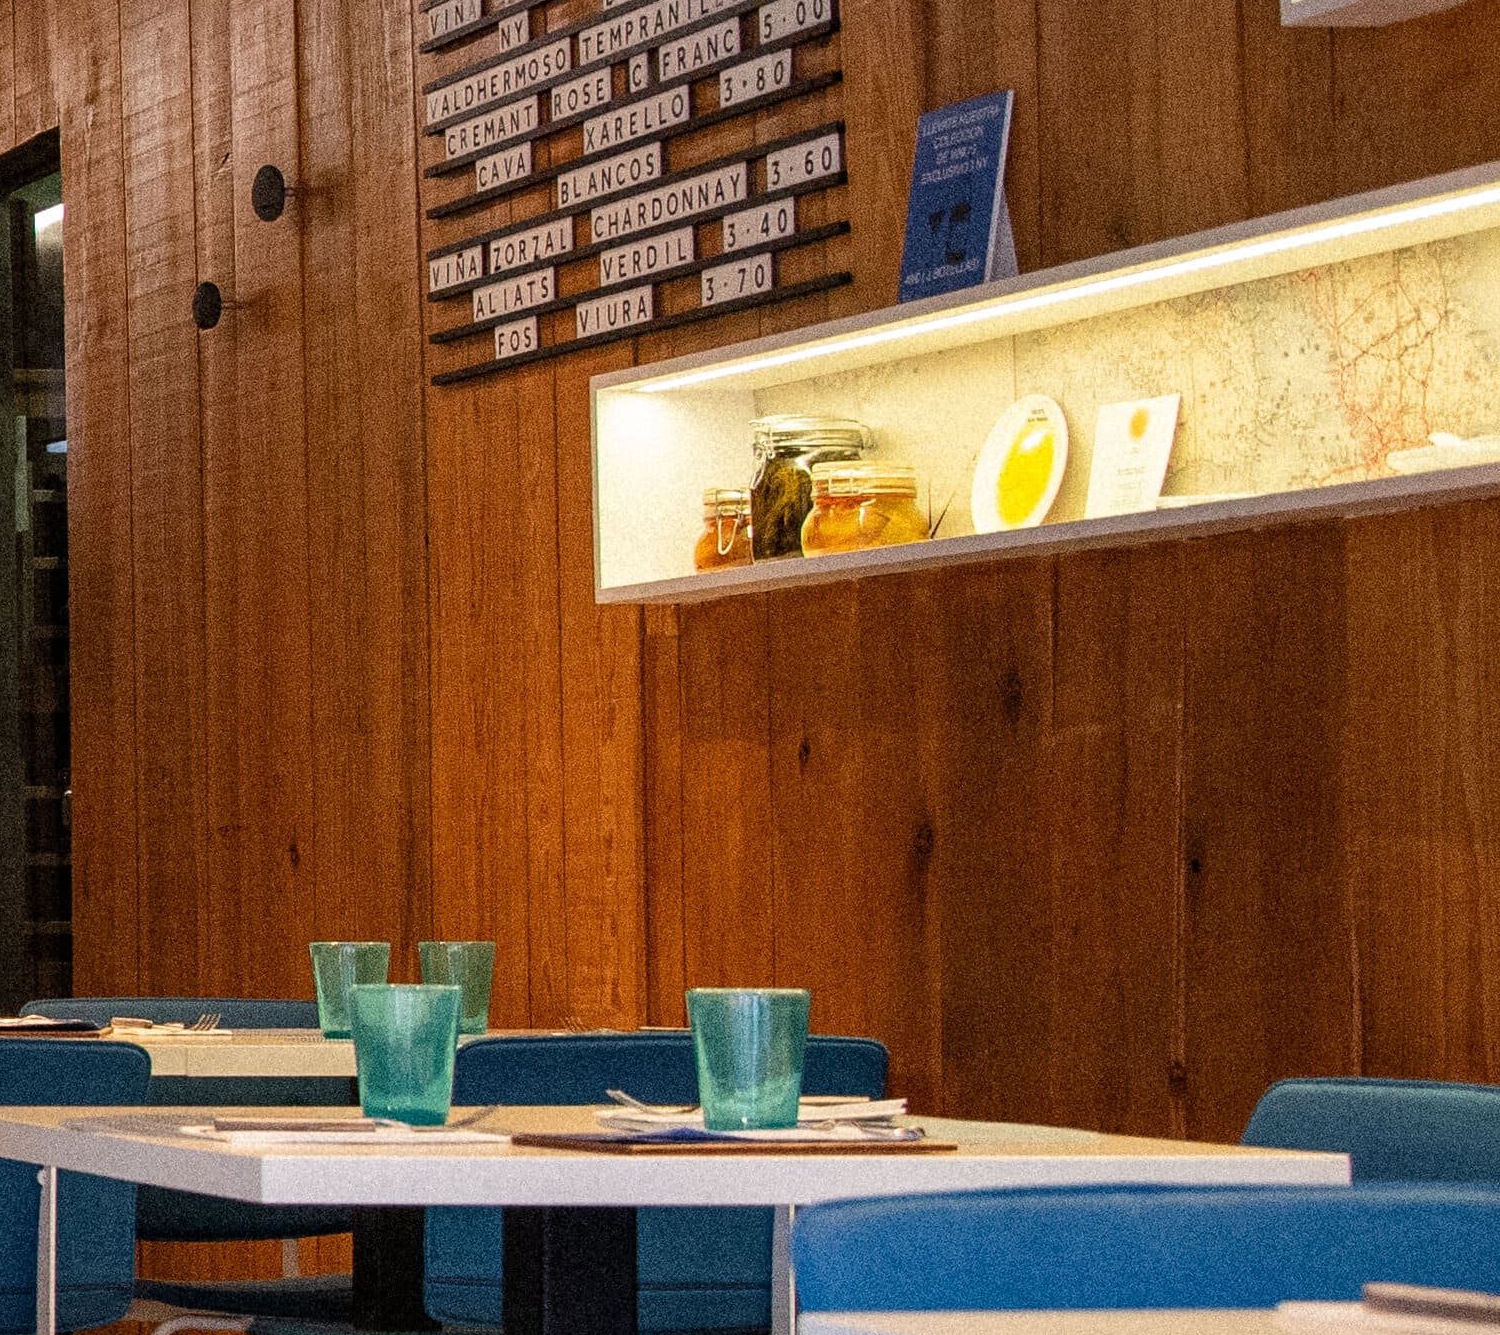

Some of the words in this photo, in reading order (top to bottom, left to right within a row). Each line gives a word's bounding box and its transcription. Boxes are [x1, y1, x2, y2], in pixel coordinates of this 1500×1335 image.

[500, 19, 523, 47] NY
[429, 48, 566, 119] VALDHERMOSO
[447, 105, 533, 155] CREMANT
[554, 78, 605, 116] ROSE
[632, 64, 642, 87] C
[662, 29, 734, 76] FRANC
[478, 152, 526, 188] CAVA
[585, 93, 684, 150] XARELLO
[561, 152, 655, 205] BLANCOS
[432, 252, 477, 287] VIÑA
[493, 228, 567, 271] ZORZAL
[593, 173, 741, 238] CHARDONNAY
[475, 276, 549, 319] ALIATS
[602, 237, 688, 281] VERDIL
[498, 326, 532, 356] FOS
[578, 295, 648, 333] VIURA
